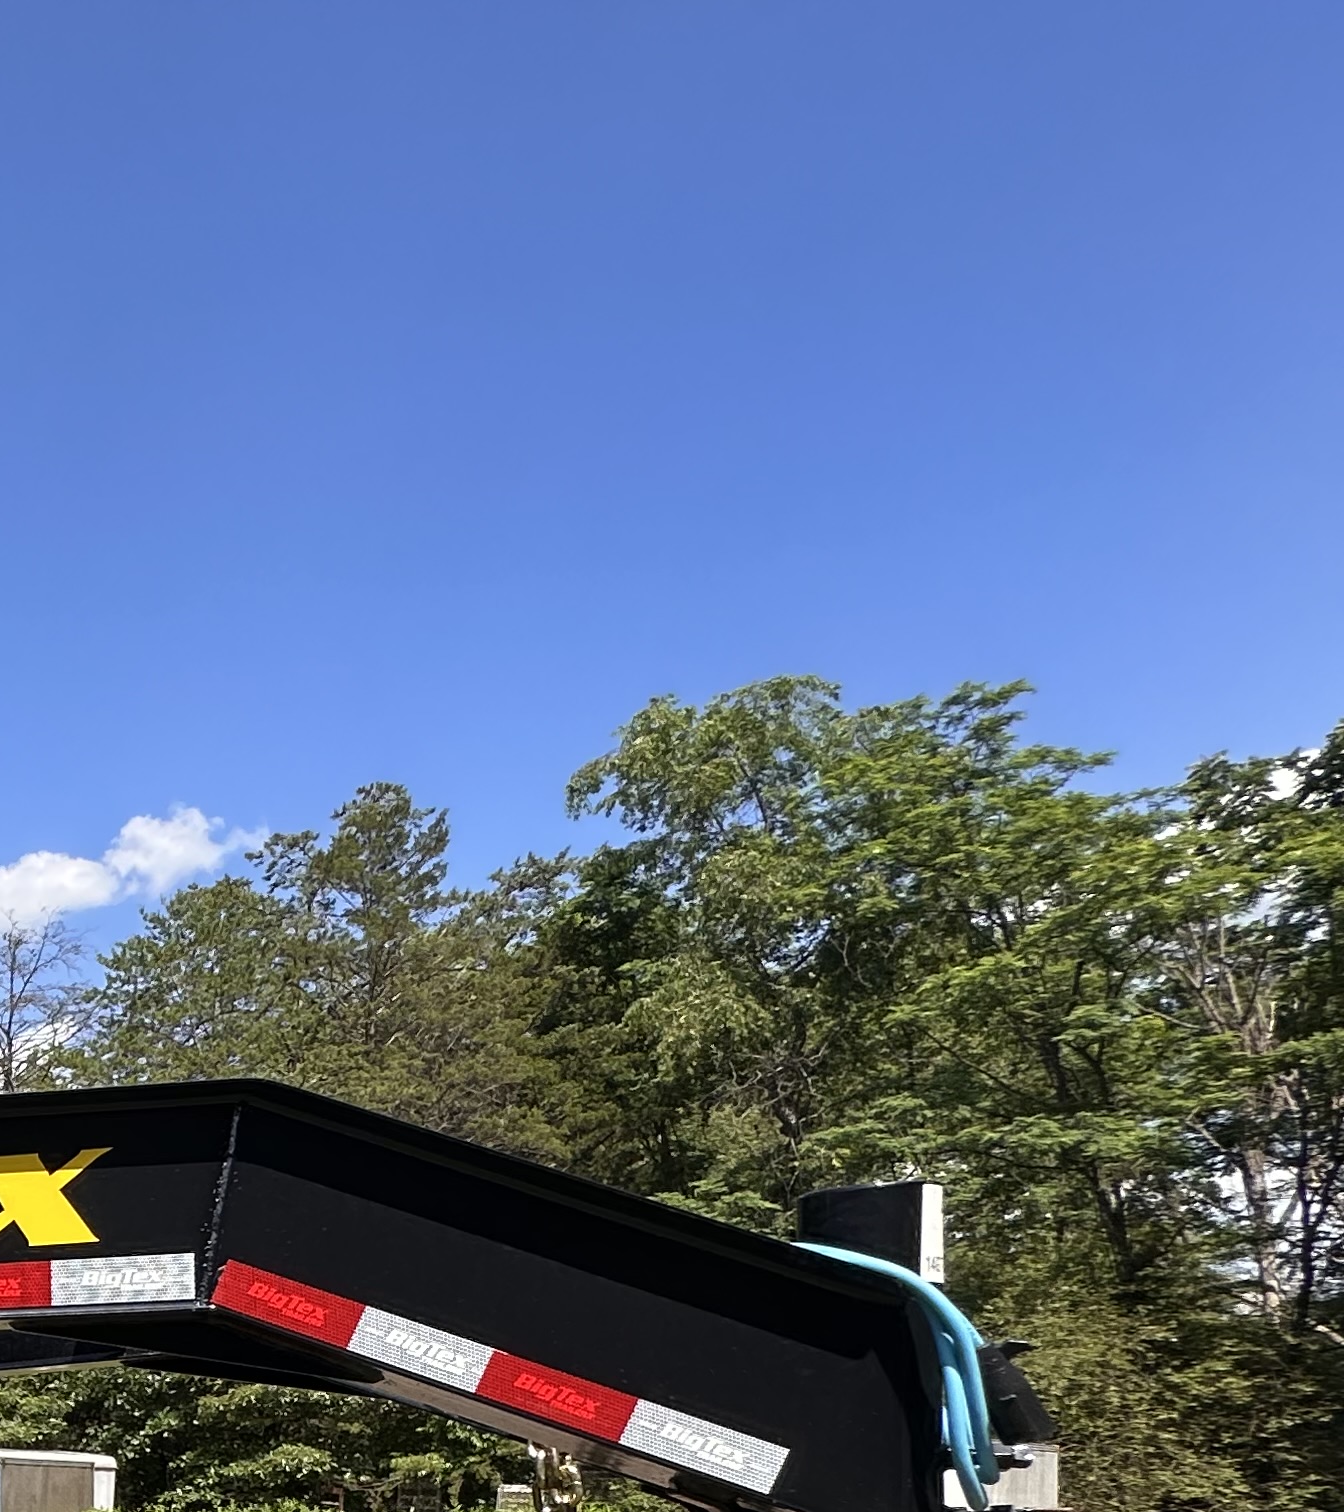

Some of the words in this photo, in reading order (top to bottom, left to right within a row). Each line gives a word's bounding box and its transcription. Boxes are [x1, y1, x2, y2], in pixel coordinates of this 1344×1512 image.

[81, 1268, 164, 1287] BigTex
[247, 1282, 328, 1321] BigTex
[384, 1328, 476, 1369] BigTex
[514, 1373, 601, 1413] BigTex
[662, 1422, 751, 1463] BigTex
